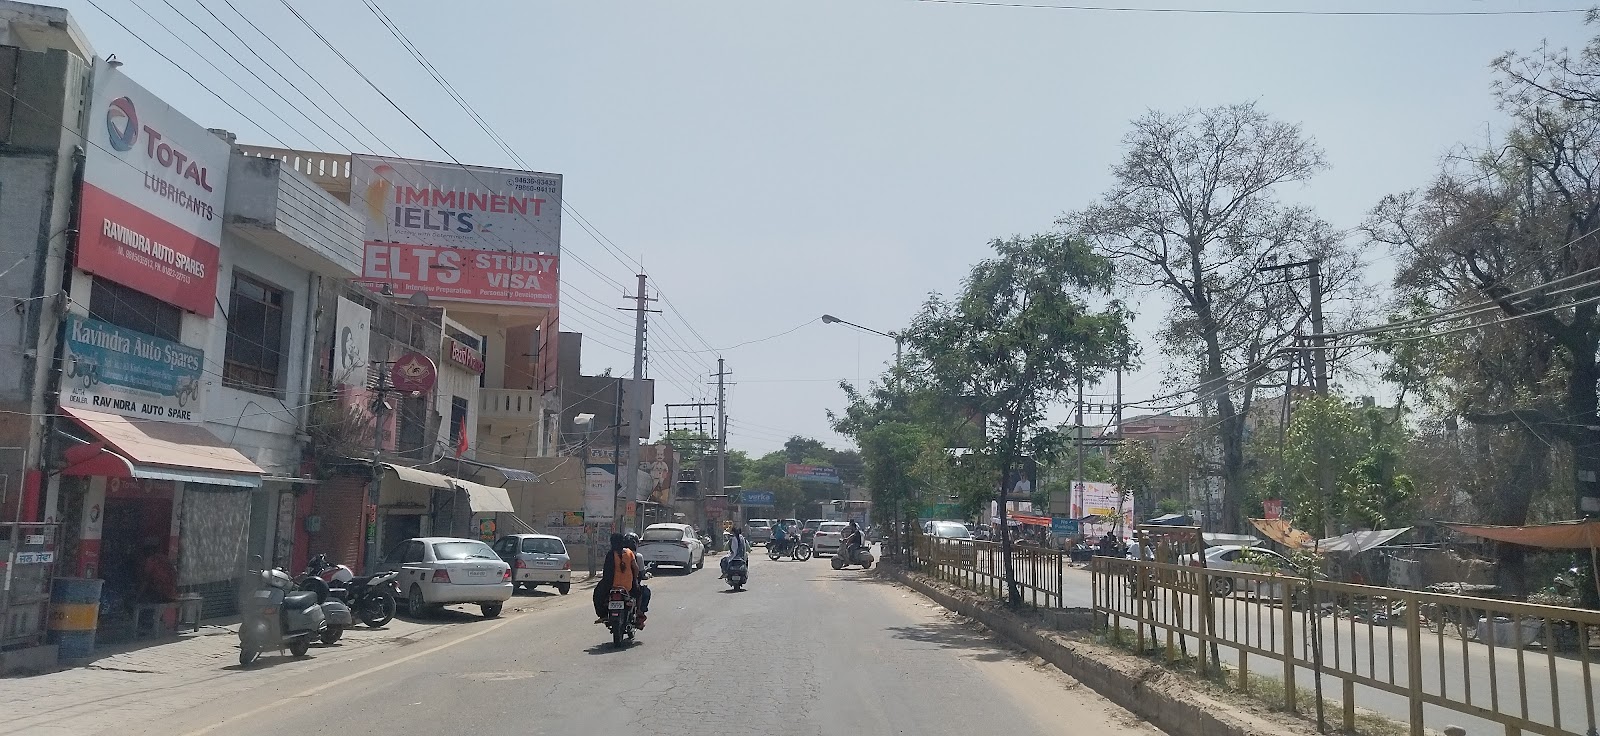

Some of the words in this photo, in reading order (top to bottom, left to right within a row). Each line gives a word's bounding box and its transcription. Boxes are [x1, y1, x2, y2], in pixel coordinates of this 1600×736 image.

[144, 124, 213, 192] TOTAL
[144, 170, 213, 221] LUBRICANTS
[395, 185, 546, 217] IMMINENT
[394, 206, 474, 233] IELTS
[103, 217, 151, 256] RAVINDRA
[152, 241, 175, 265] AUTO
[175, 251, 205, 279] SPARES
[364, 244, 461, 285] ELTS
[475, 252, 554, 273] STUDY
[405, 284, 435, 293] Interview
[435, 285, 472, 296] Preparation
[479, 288, 513, 298] Personality
[514, 290, 553, 300] Development
[486, 272, 541, 290] VISA
[71, 319, 130, 355] Ravindra
[133, 337, 162, 362] Auto
[164, 344, 199, 371] Spares
[92, 395, 137, 413] RAVNDRA
[141, 403, 164, 416] AUTO
[167, 407, 192, 421] SPARE
